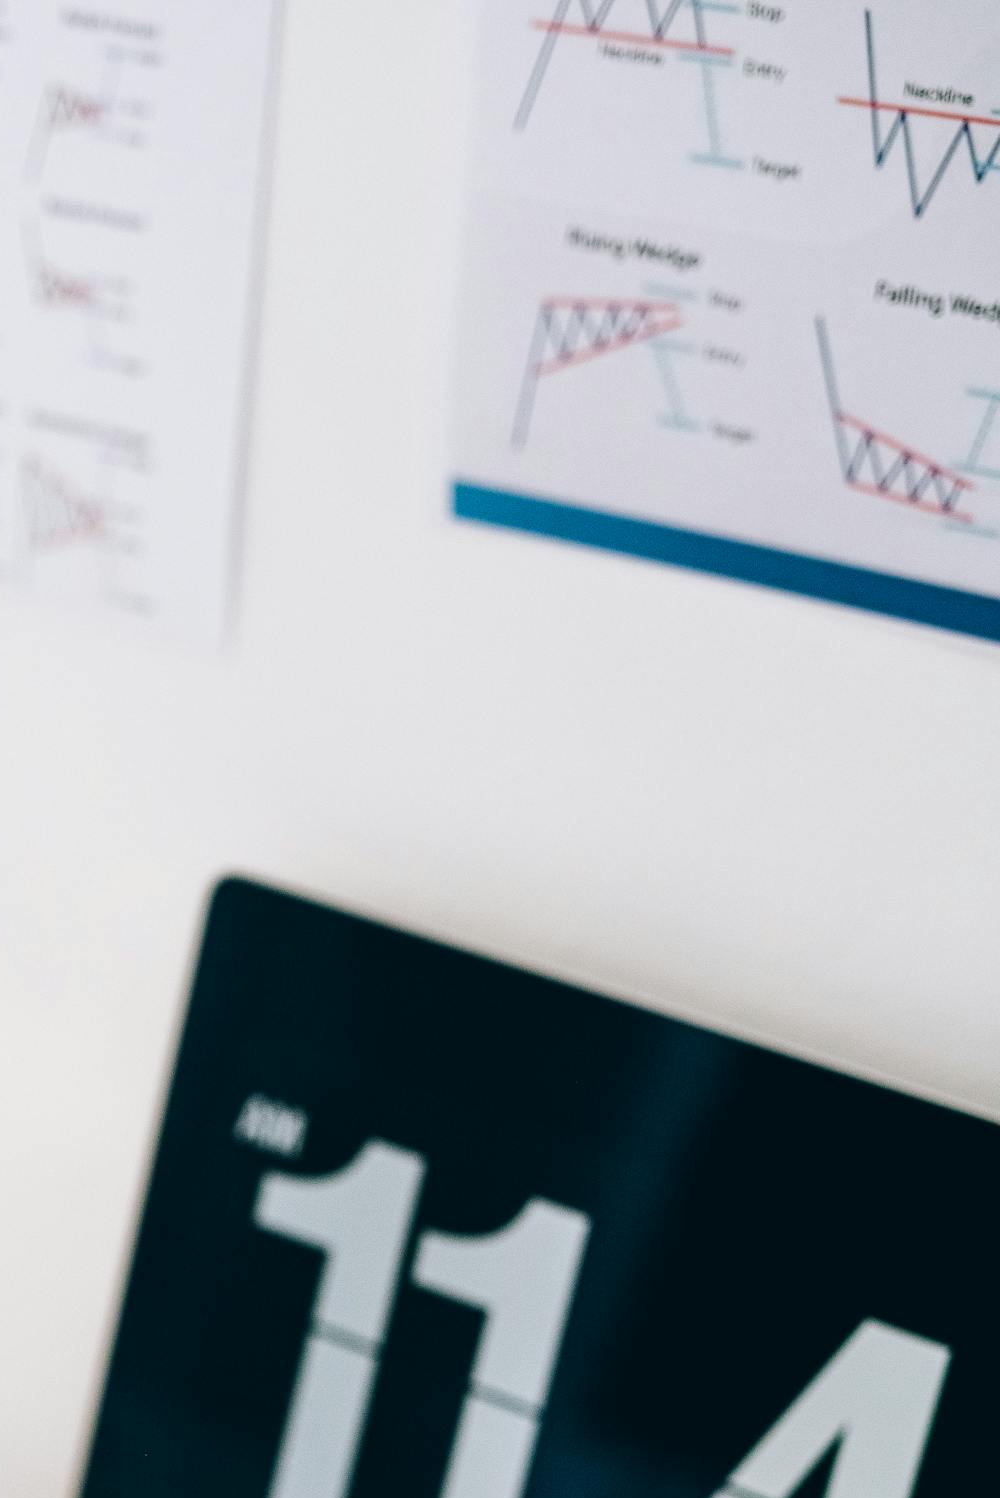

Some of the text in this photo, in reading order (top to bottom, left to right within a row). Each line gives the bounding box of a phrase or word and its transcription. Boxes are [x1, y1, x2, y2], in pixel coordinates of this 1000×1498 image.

[904, 80, 976, 107] Neckline
[874, 279, 1000, 328] Falling Wed
